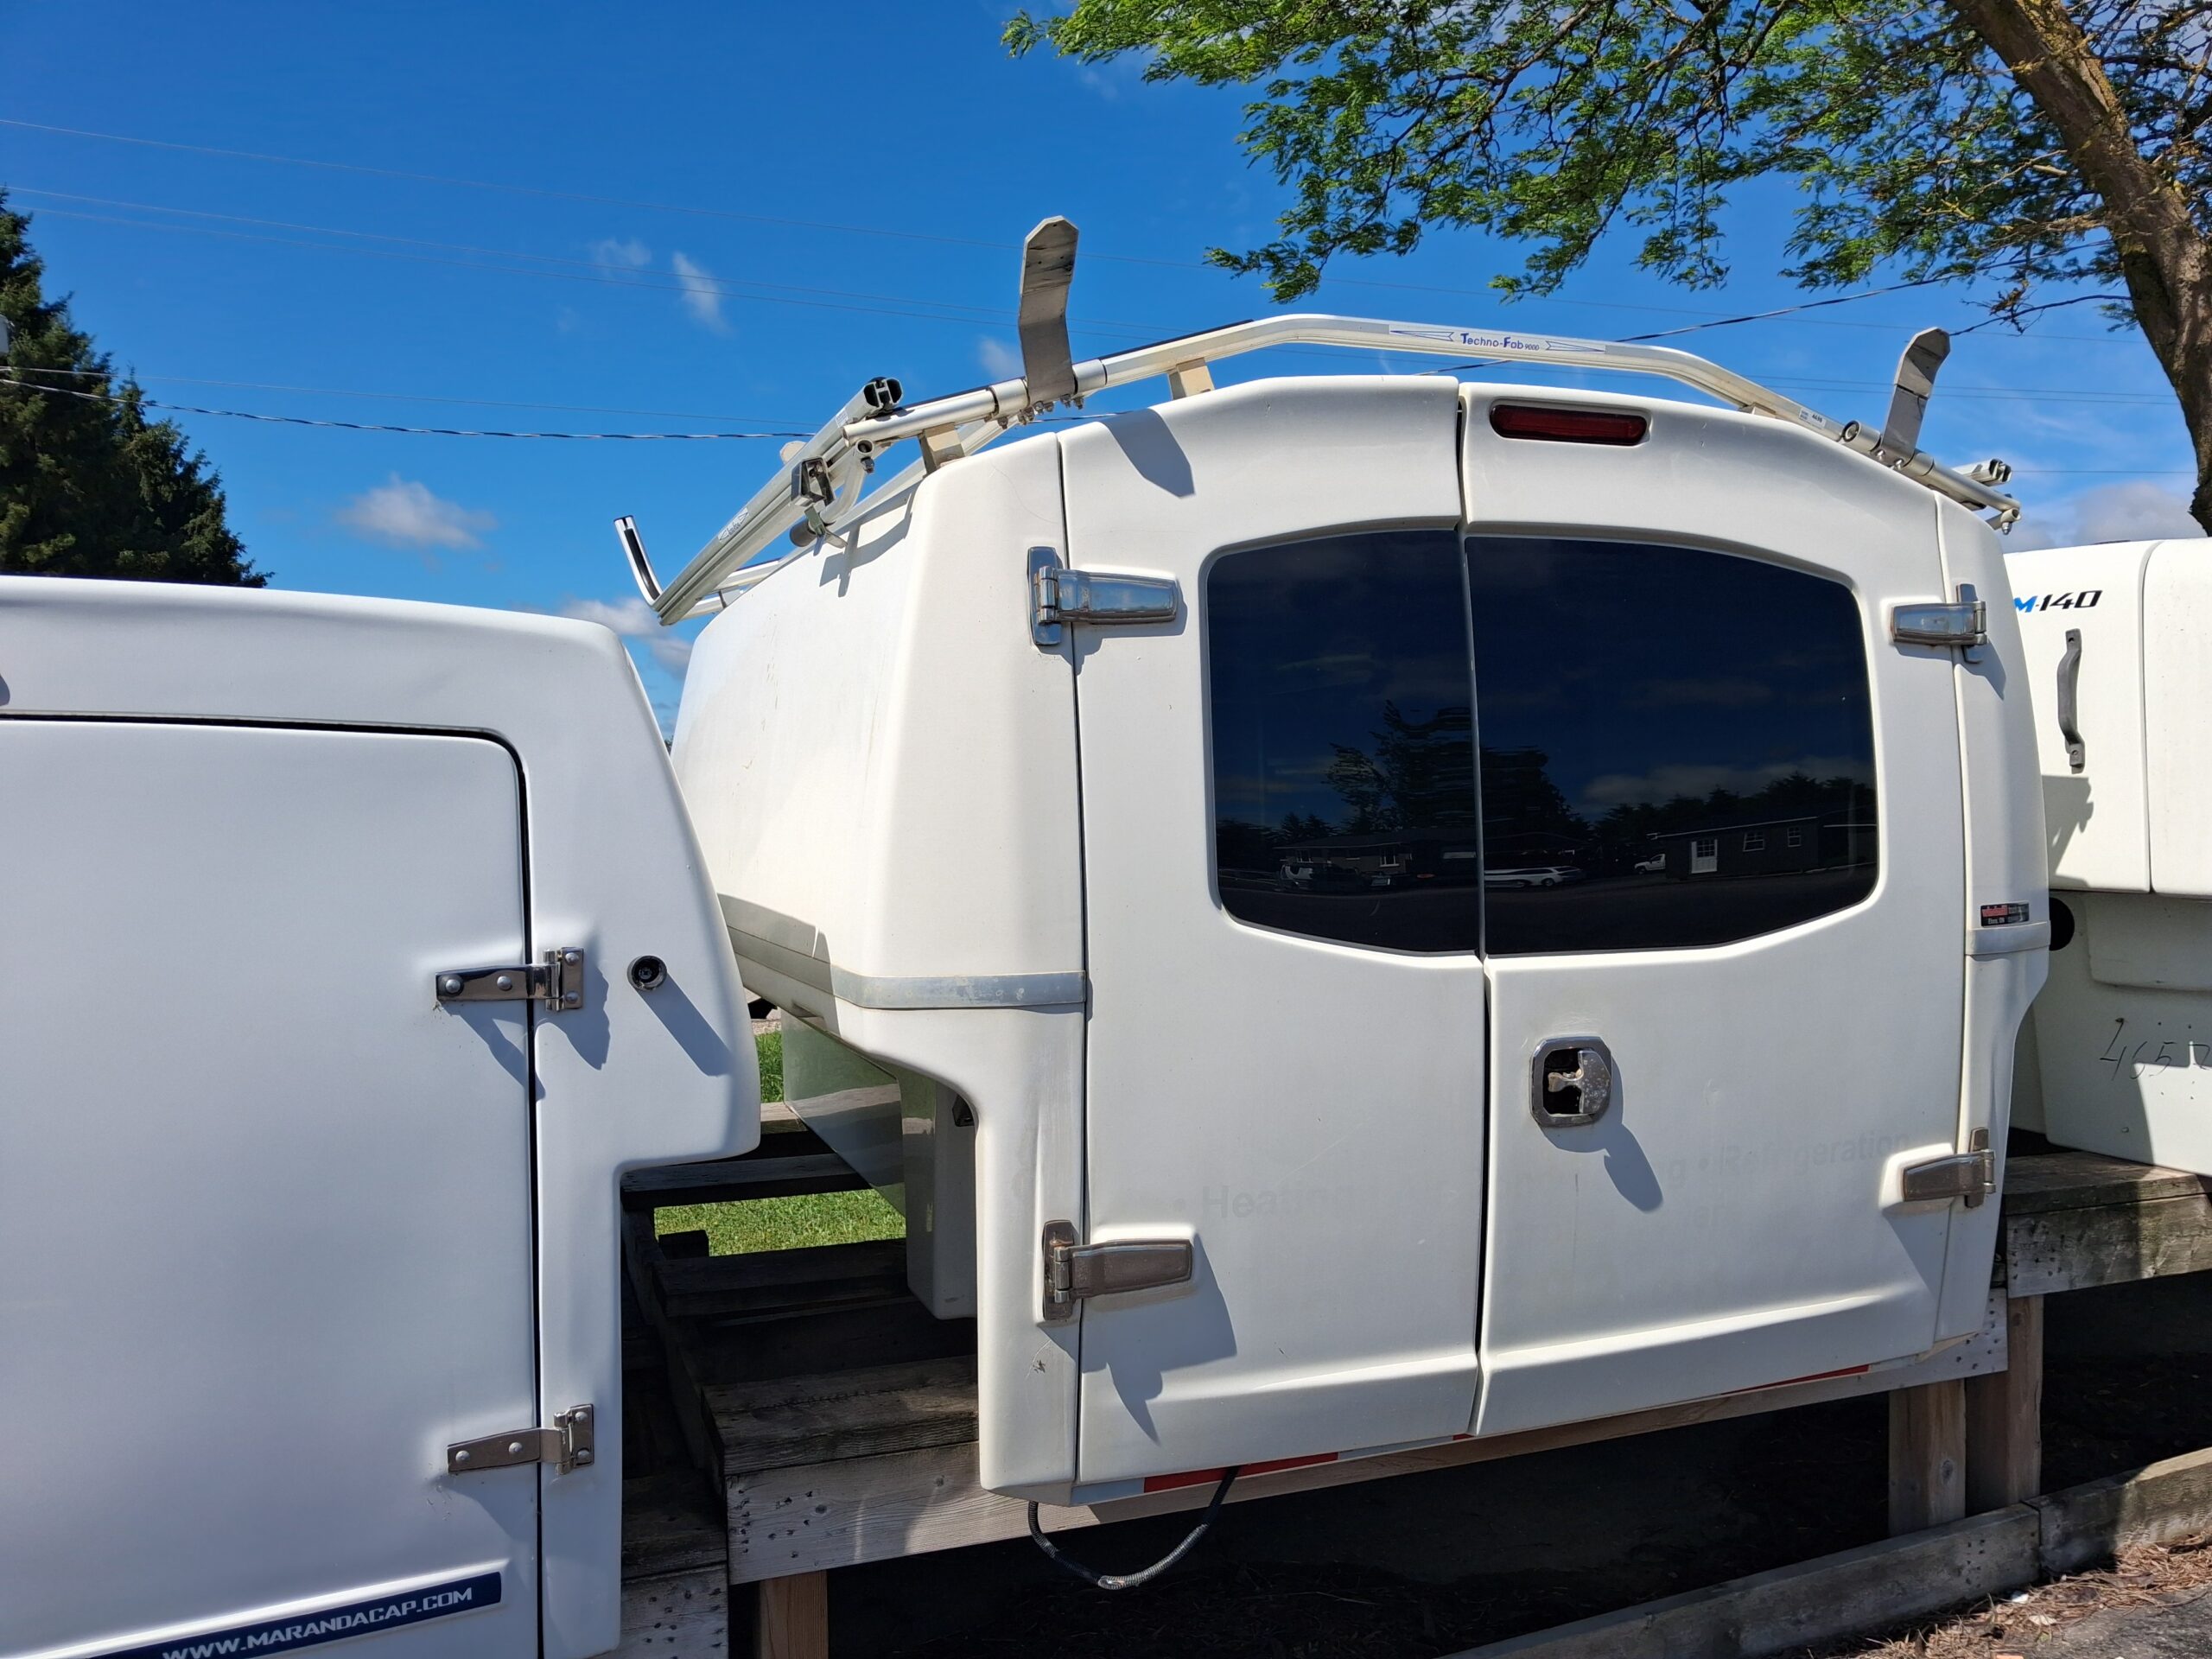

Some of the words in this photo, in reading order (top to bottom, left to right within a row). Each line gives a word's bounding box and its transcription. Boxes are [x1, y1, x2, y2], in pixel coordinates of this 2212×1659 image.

[1460, 332, 1523, 349] Techno-Fab
[2012, 589, 2103, 613] M-140
[162, 1586, 473, 1659] WWW.MARANDACAP.COM
